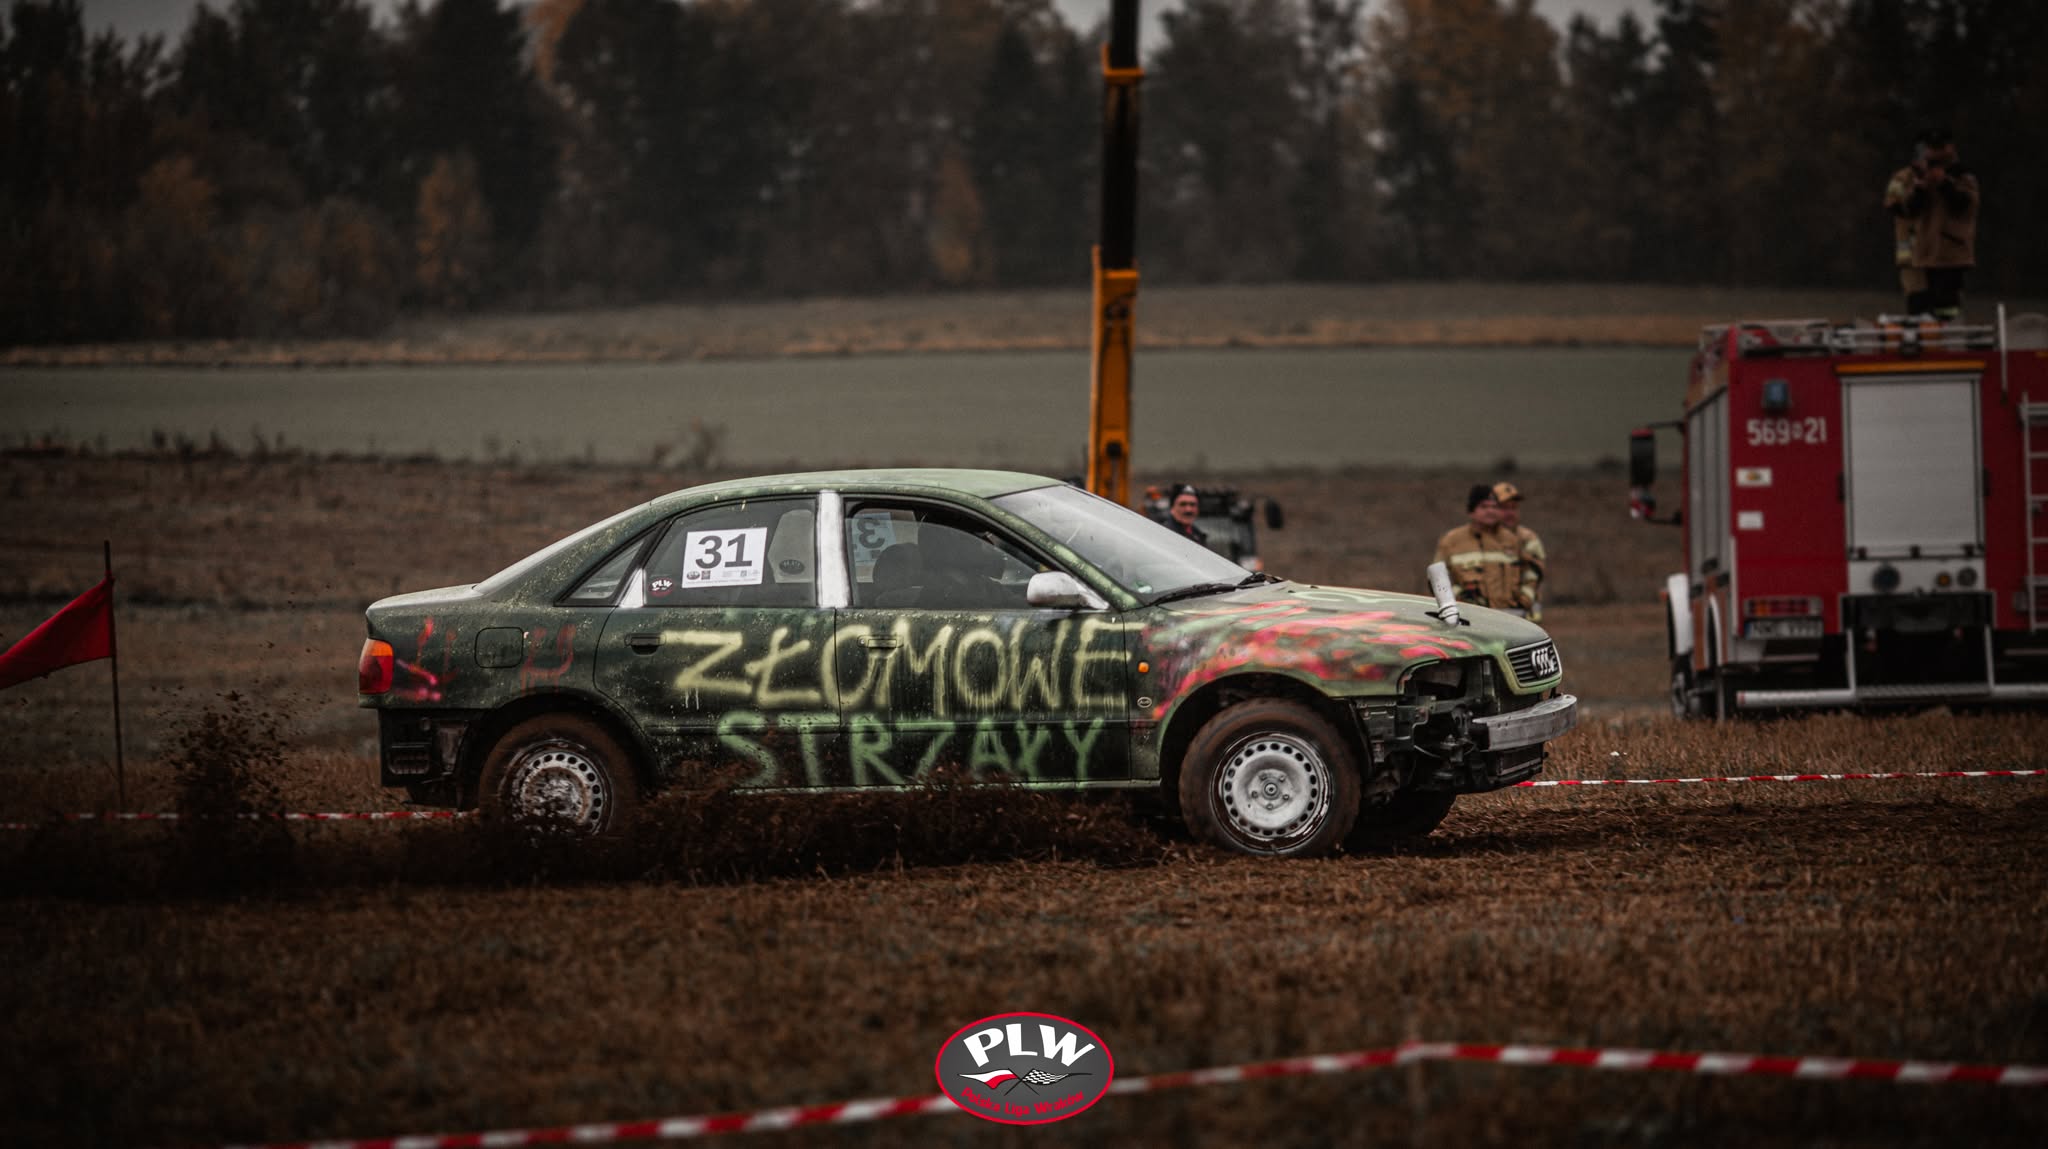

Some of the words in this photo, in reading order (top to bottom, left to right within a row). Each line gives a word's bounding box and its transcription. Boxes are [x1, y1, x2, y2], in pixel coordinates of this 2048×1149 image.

[695, 533, 753, 569] 31
[651, 579, 673, 589] PLW
[662, 618, 1146, 714] ZŁOMOWE
